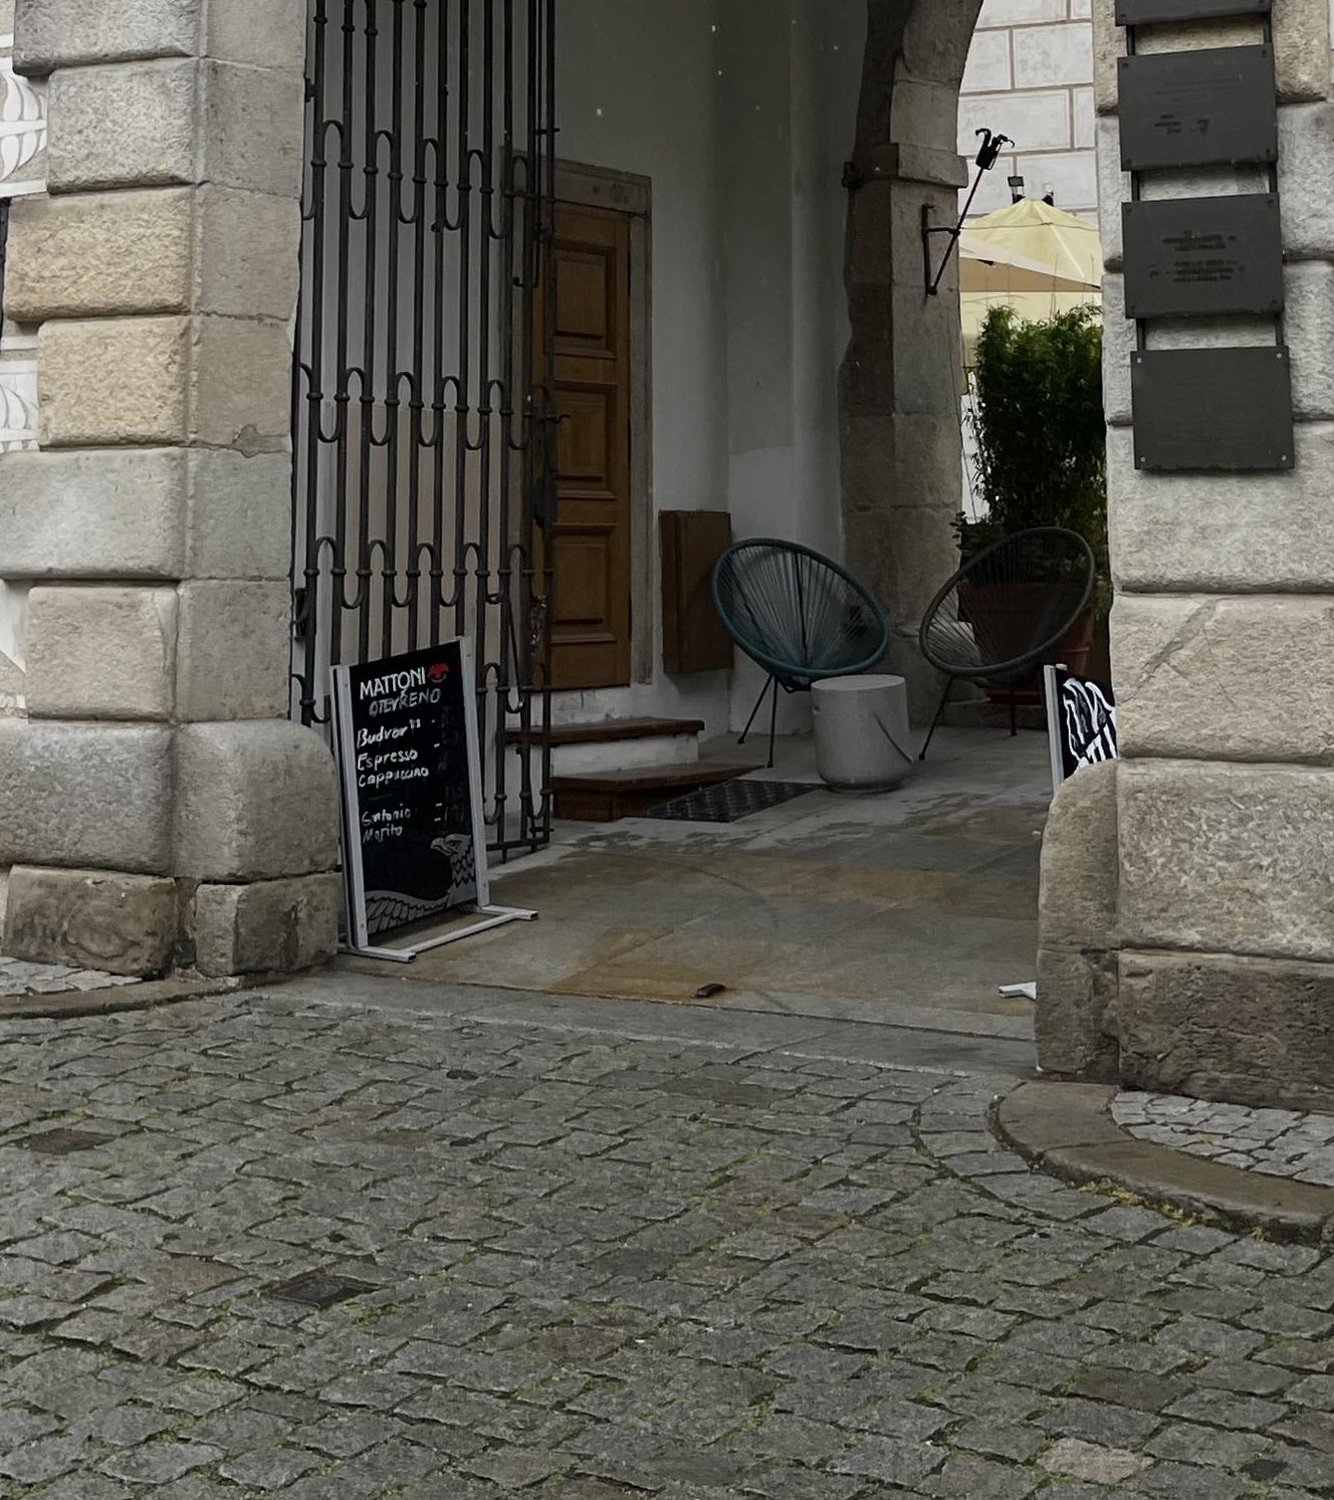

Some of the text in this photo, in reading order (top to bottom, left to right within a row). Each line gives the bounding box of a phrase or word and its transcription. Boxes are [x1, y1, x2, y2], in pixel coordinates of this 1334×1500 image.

[359, 666, 426, 700] MATTONI
[357, 747, 418, 772] Espresso
[358, 766, 429, 789] Cappuccino
